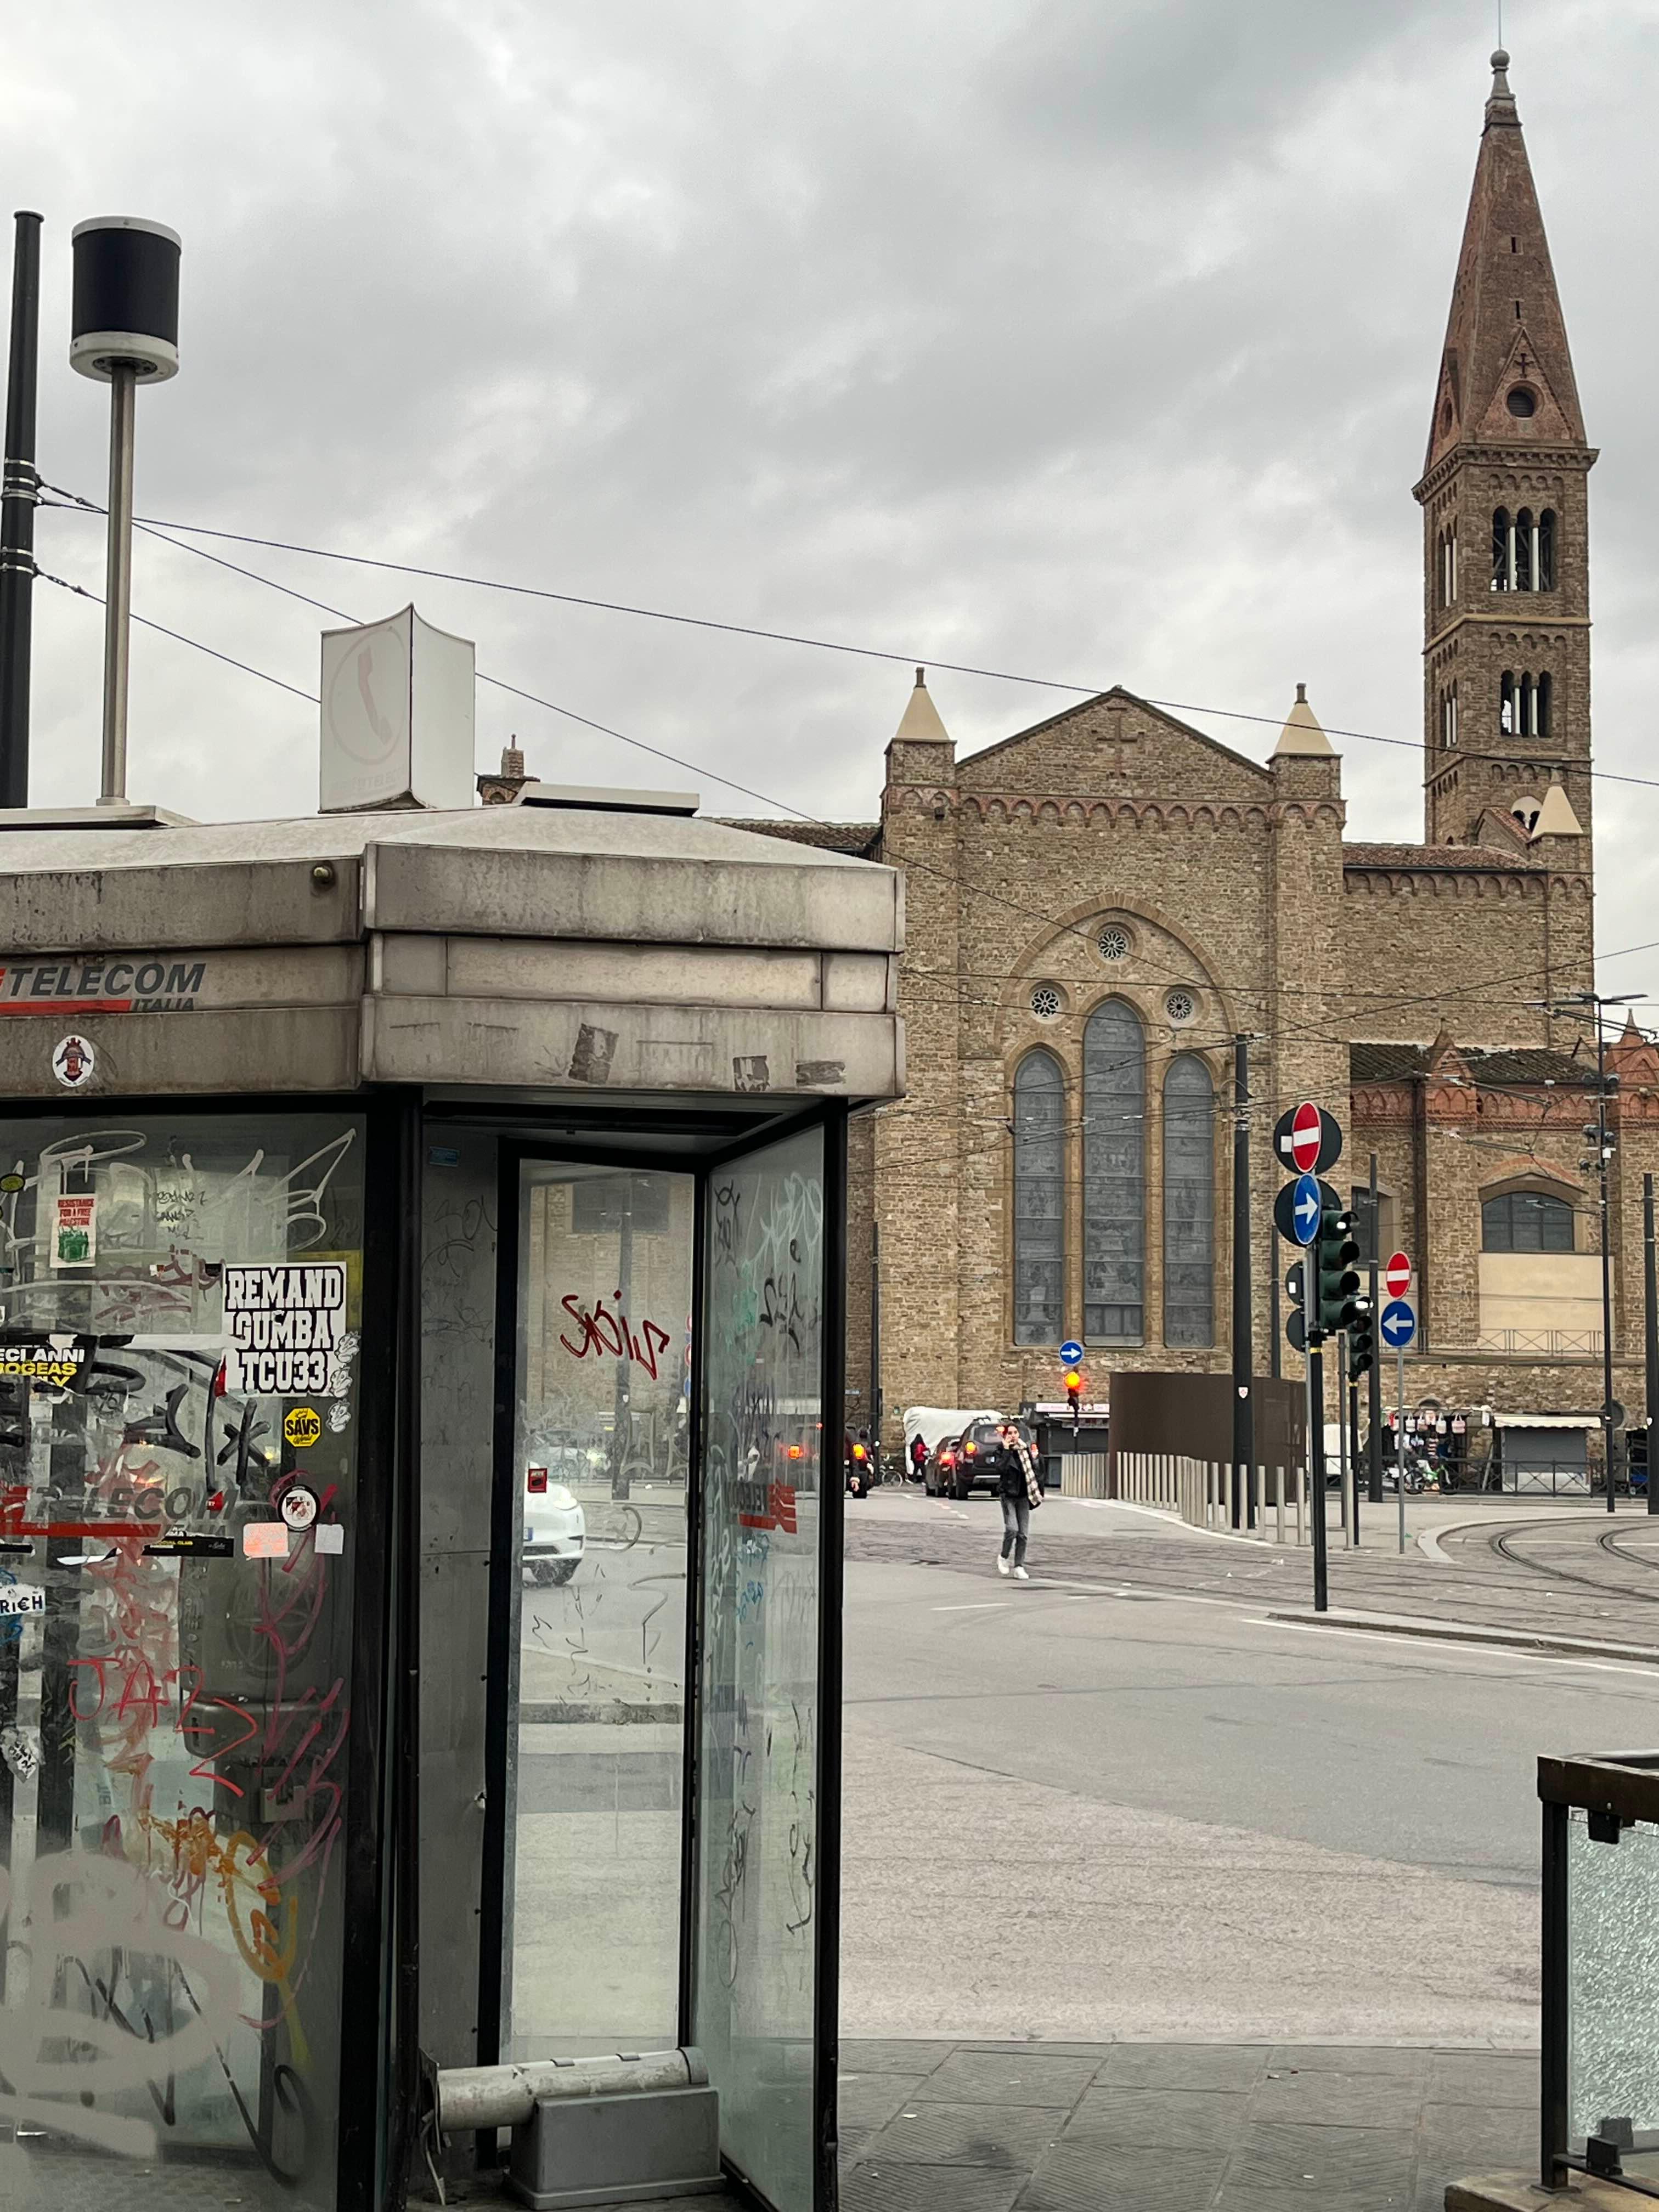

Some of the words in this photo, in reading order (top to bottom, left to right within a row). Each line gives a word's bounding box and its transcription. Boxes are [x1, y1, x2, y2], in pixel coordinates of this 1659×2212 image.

[10, 963, 206, 996] TELECOM
[133, 998, 194, 1011] ITALIA
[227, 1269, 341, 1308] REMAND
[32, 1348, 85, 1363] ANNI
[241, 1351, 326, 1393] TCU33
[286, 1418, 319, 1436] SAVS
